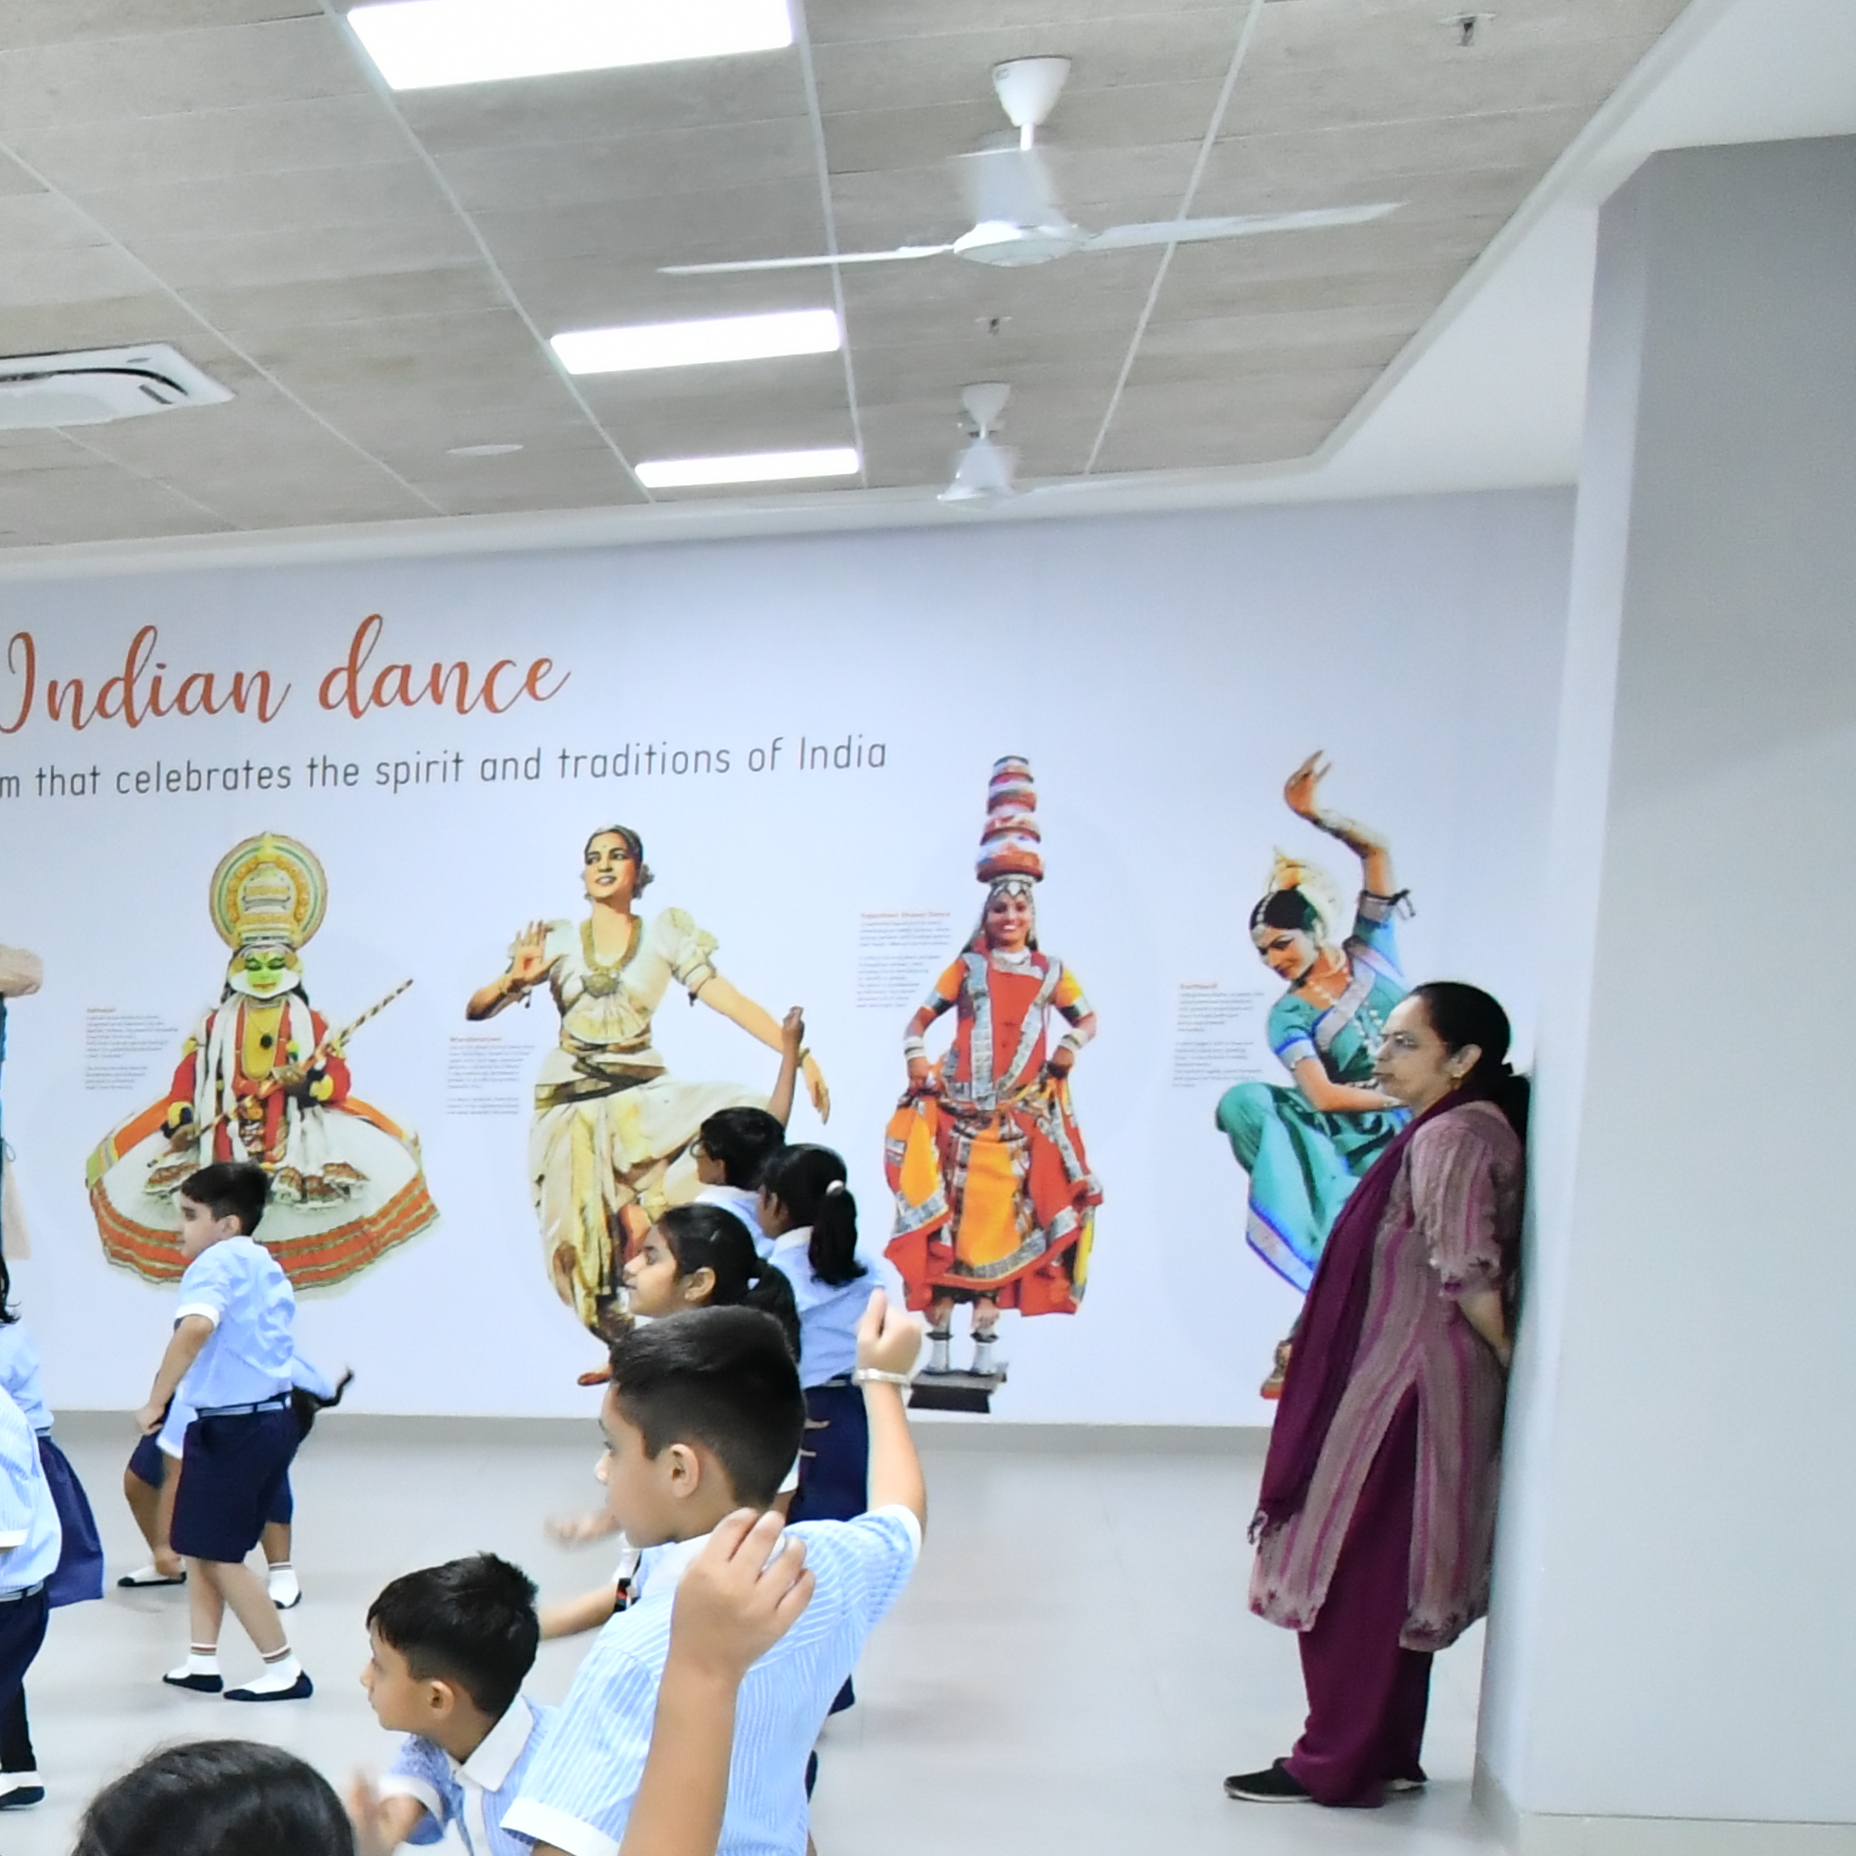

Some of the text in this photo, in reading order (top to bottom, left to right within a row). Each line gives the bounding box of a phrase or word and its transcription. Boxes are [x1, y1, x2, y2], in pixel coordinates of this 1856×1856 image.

[319, 613, 571, 719] dance
[36, 765, 100, 796] that
[116, 760, 291, 794] celebrates
[307, 755, 359, 787] the
[376, 749, 463, 794] spirit
[481, 747, 541, 781] and
[558, 741, 730, 778] traditions
[749, 737, 783, 772] of
[800, 733, 886, 769] India
